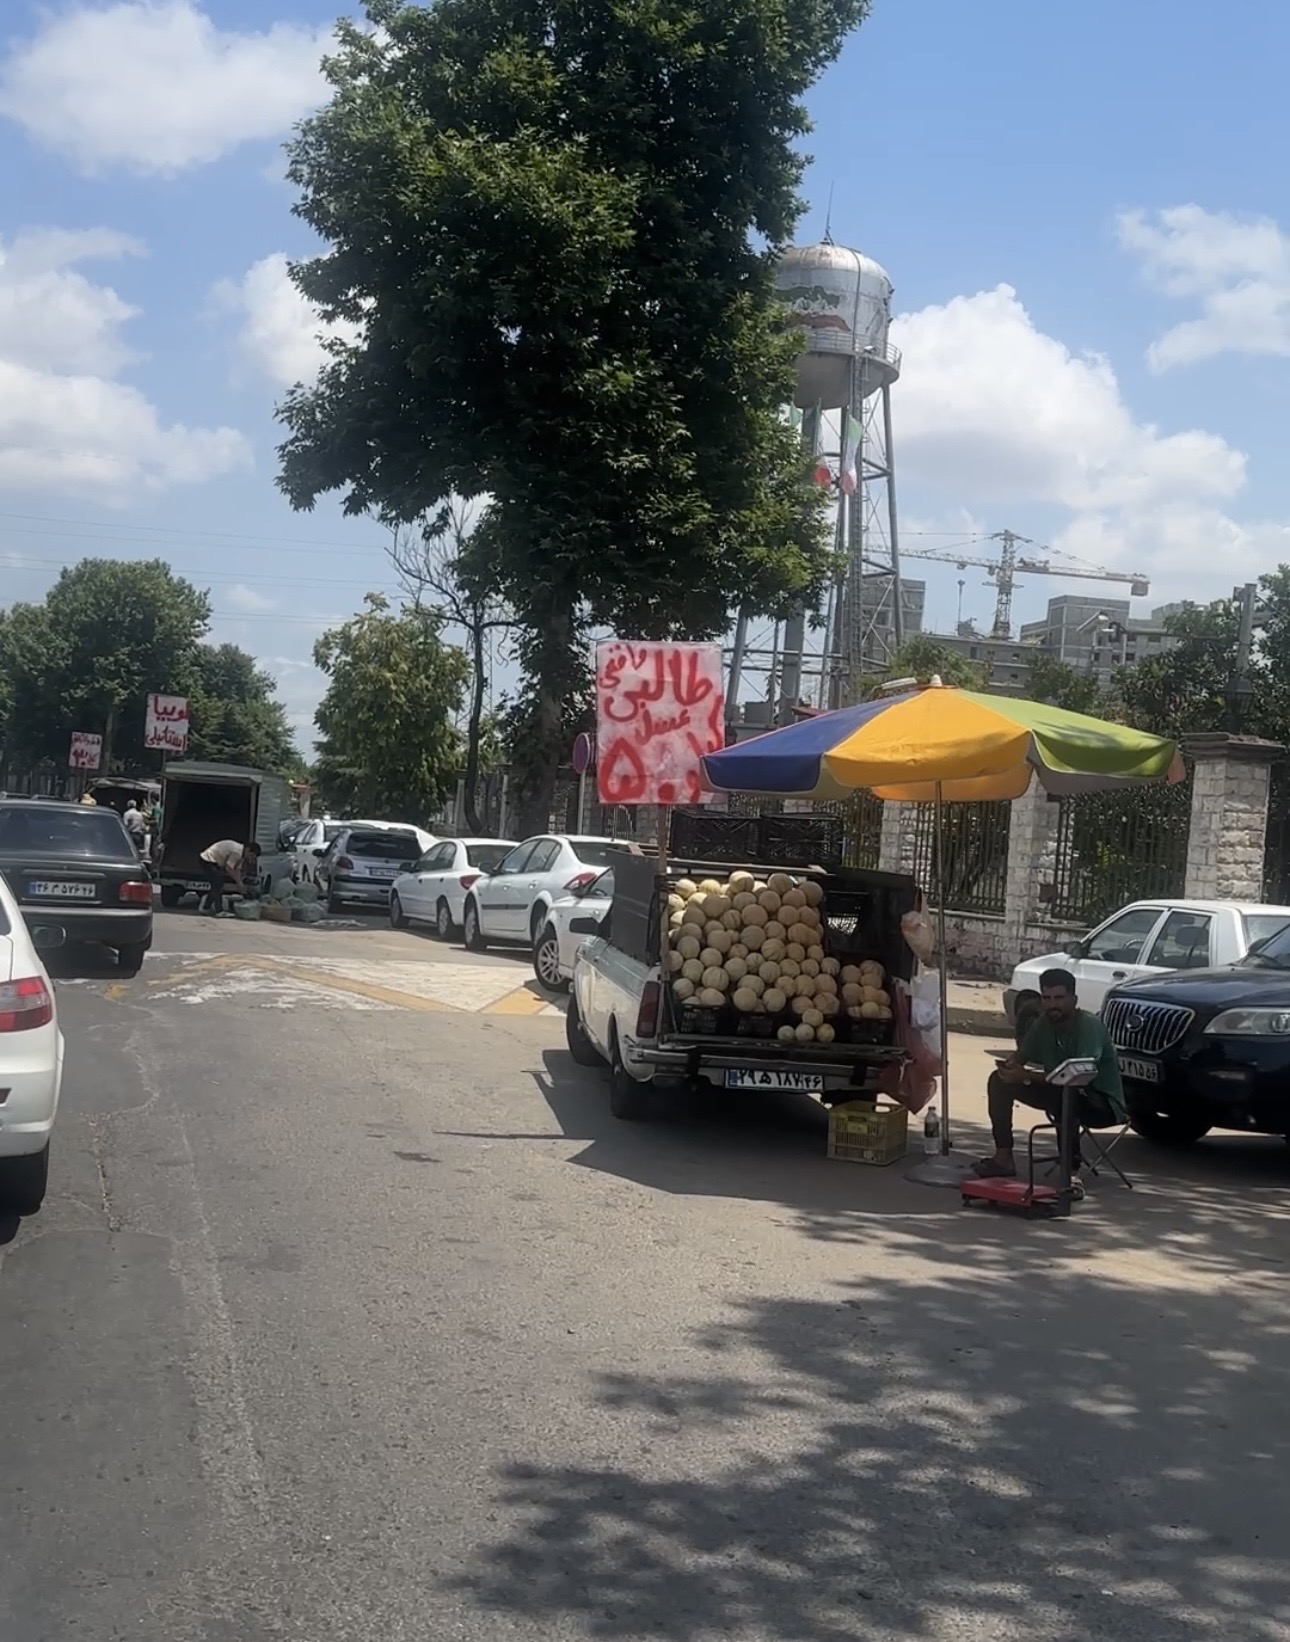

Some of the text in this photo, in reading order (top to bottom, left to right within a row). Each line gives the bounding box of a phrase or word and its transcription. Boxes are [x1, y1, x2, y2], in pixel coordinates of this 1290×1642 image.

[604, 649, 714, 722] طالبی
[154, 695, 191, 722] لوبیا
[804, 1076, 822, 1088] ۴۶
